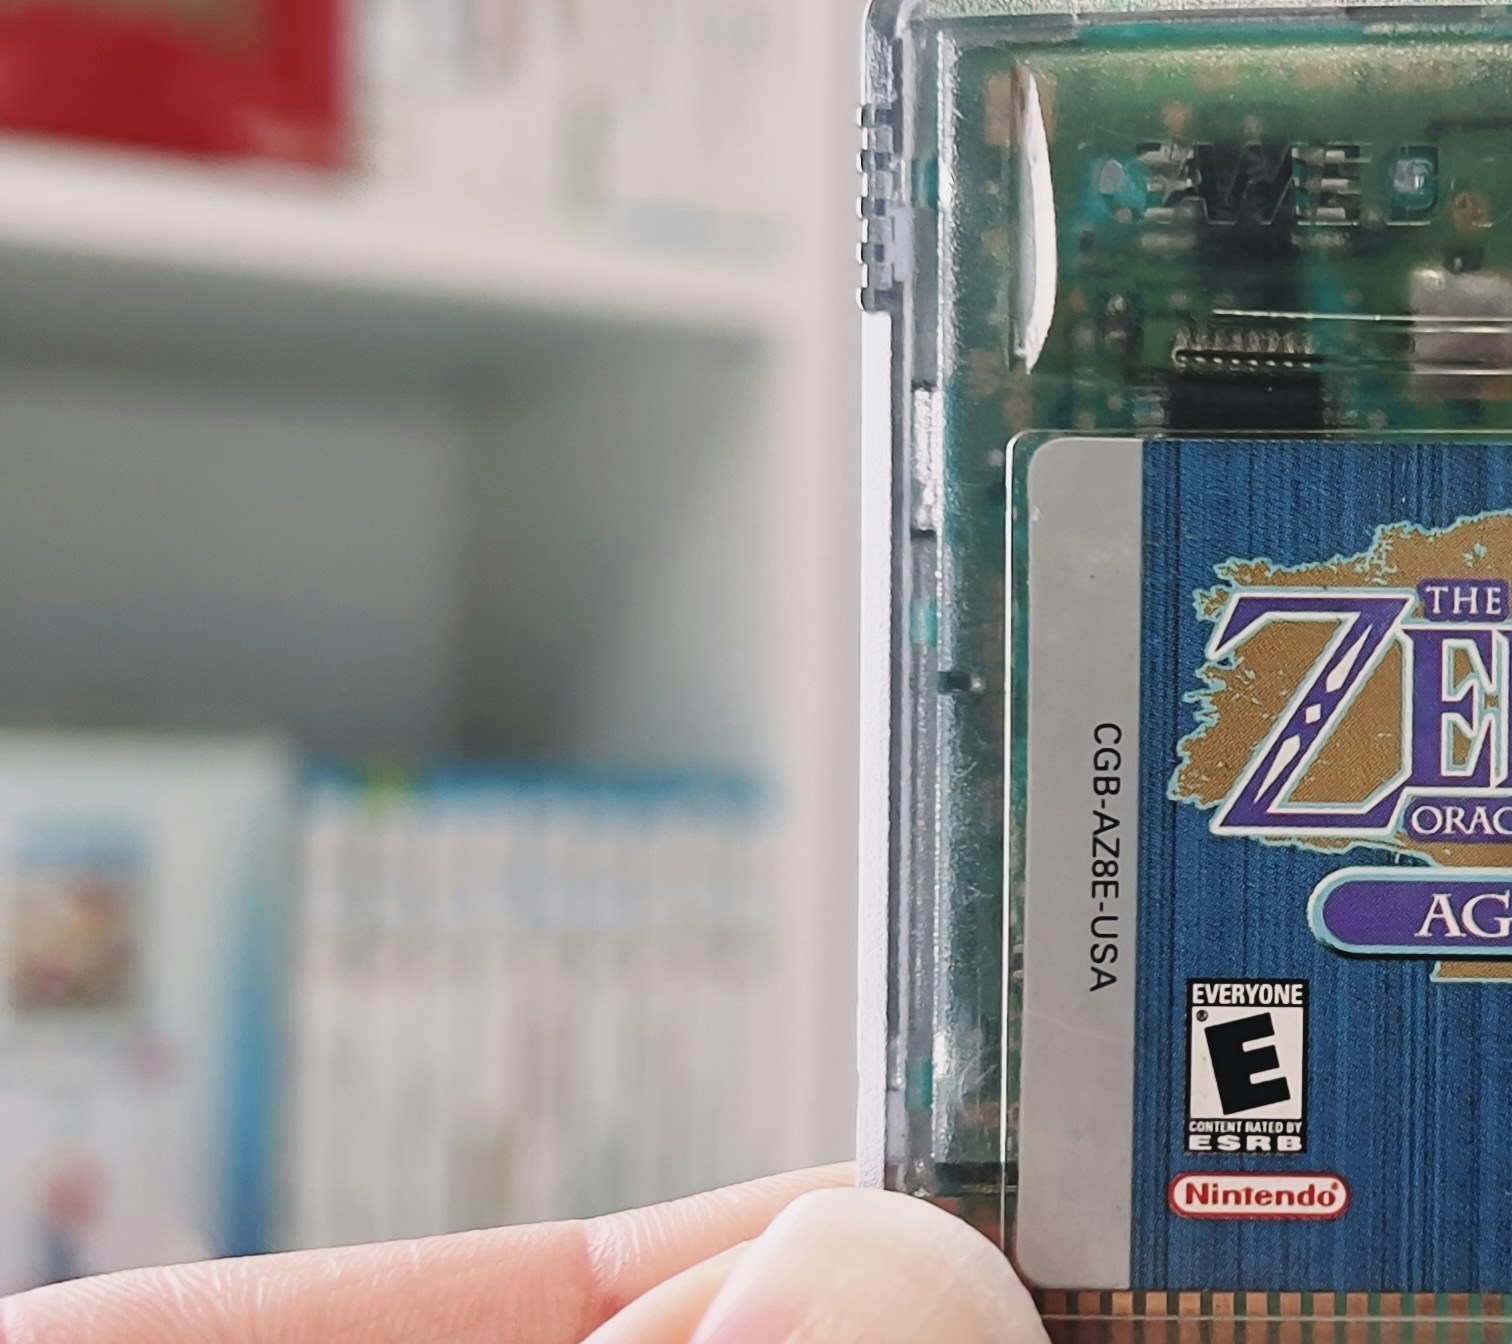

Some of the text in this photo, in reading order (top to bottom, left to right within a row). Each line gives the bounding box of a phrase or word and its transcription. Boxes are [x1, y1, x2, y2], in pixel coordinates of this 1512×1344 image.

[1425, 586, 1501, 615] THE
[1089, 722, 1122, 993] CGB-AZ8E-USA
[1192, 983, 1303, 1005] EVERYONE
[1204, 1012, 1291, 1115] E
[1188, 1120, 1303, 1134] CONTENT RATED BY
[1188, 1134, 1302, 1151] ESRB
[1185, 1182, 1337, 1206] Nintendo
